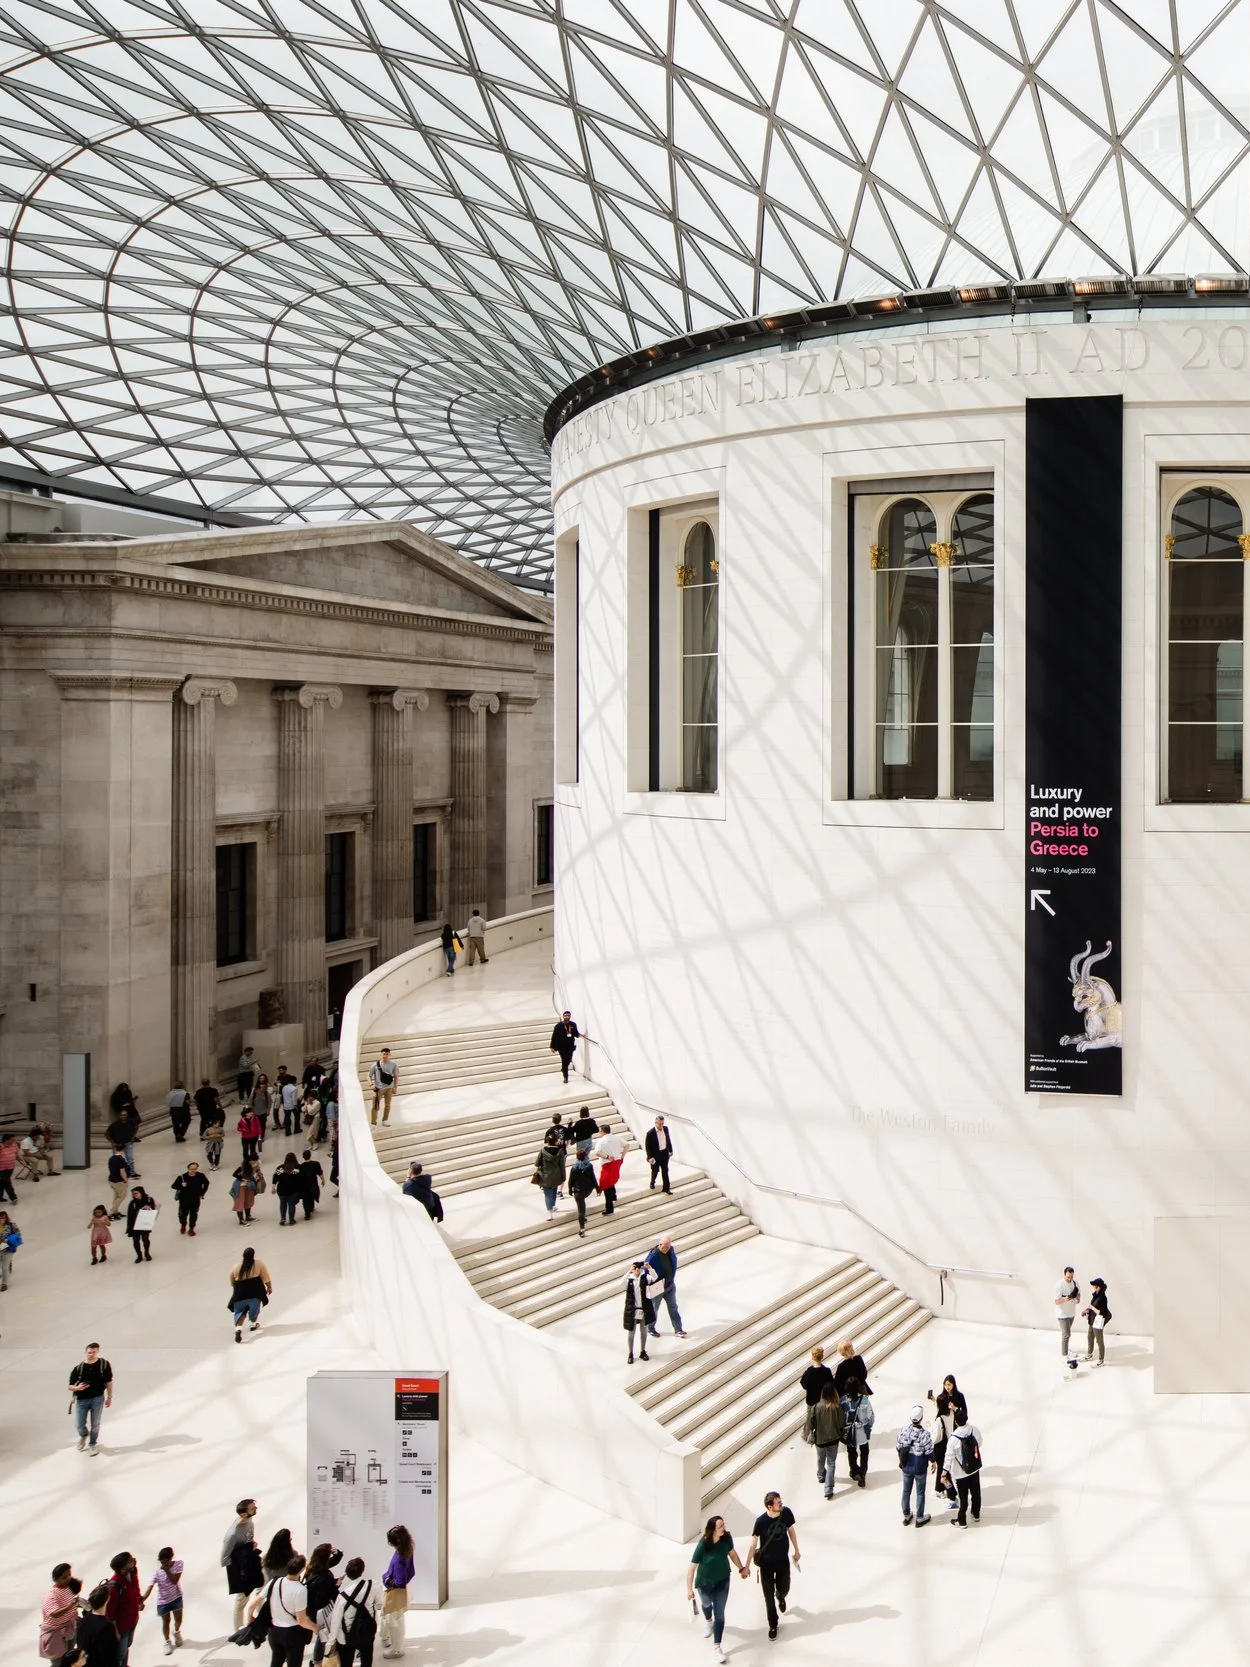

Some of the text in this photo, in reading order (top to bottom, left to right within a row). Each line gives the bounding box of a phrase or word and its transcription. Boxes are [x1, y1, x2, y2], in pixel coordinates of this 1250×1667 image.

[626, 371, 722, 436] QUEEN
[736, 335, 990, 407] ELIZABETH
[1011, 330, 1048, 377] II
[1069, 328, 1150, 374] AD
[1030, 784, 1083, 802] Luxury
[1029, 803, 1113, 821] and power
[1030, 821, 1099, 837] Persia to
[1030, 840, 1089, 856] Greece
[1035, 867, 1048, 875] May
[1060, 867, 1080, 875] August
